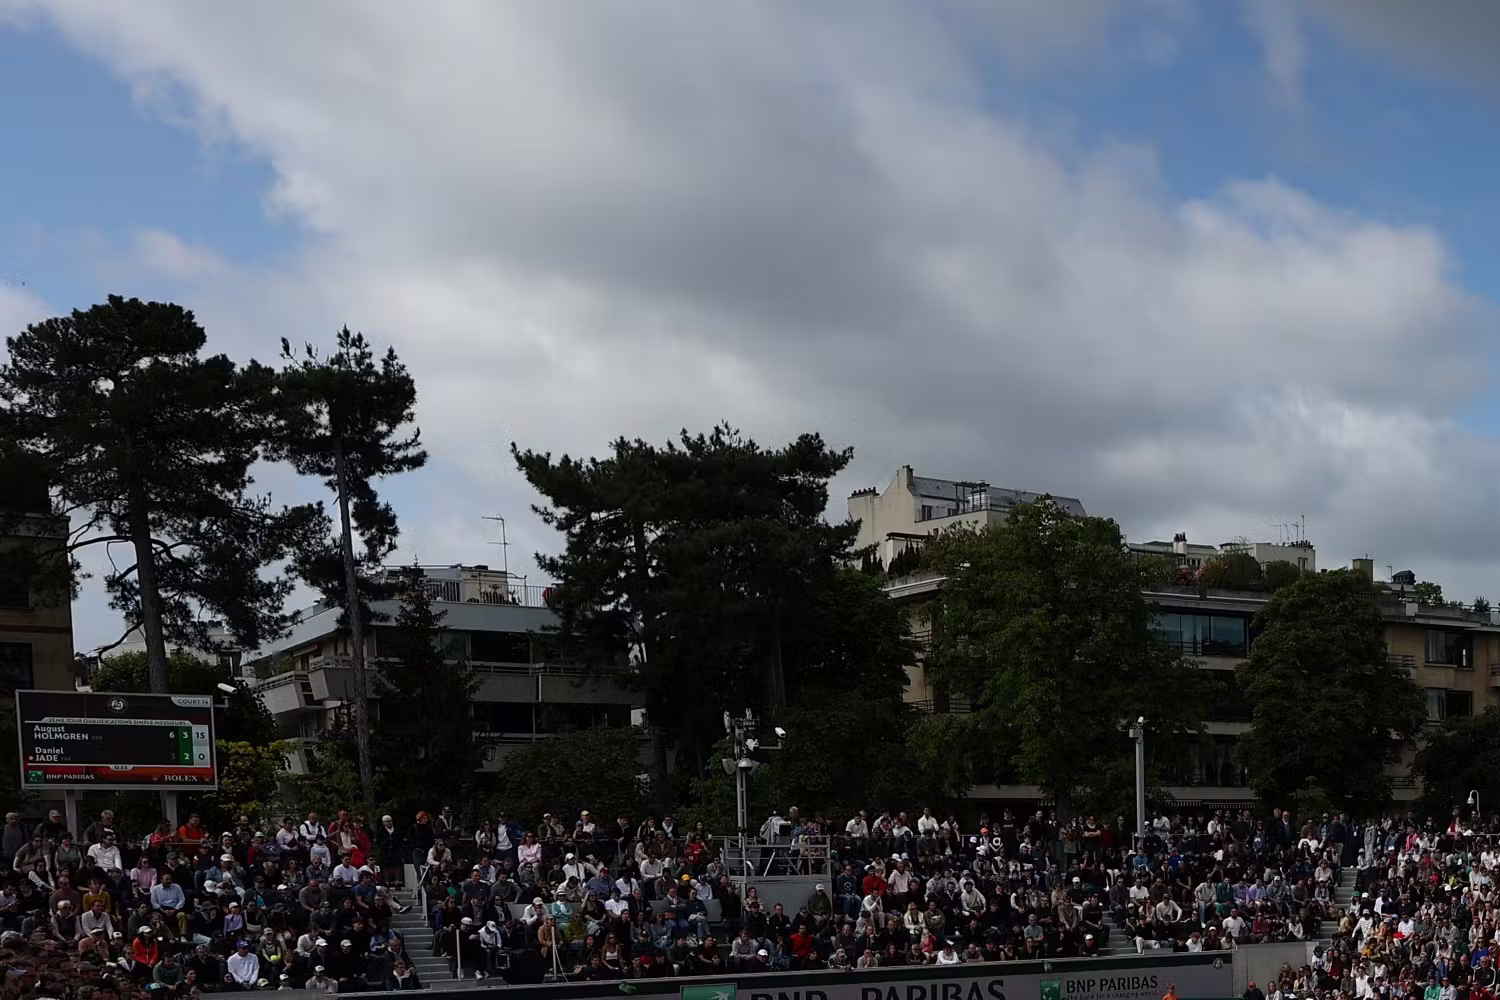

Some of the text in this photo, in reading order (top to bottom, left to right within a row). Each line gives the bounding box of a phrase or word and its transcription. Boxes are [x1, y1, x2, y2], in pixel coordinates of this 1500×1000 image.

[34, 725, 65, 733] August
[1066, 975, 1158, 994] BNP PARIBAS
